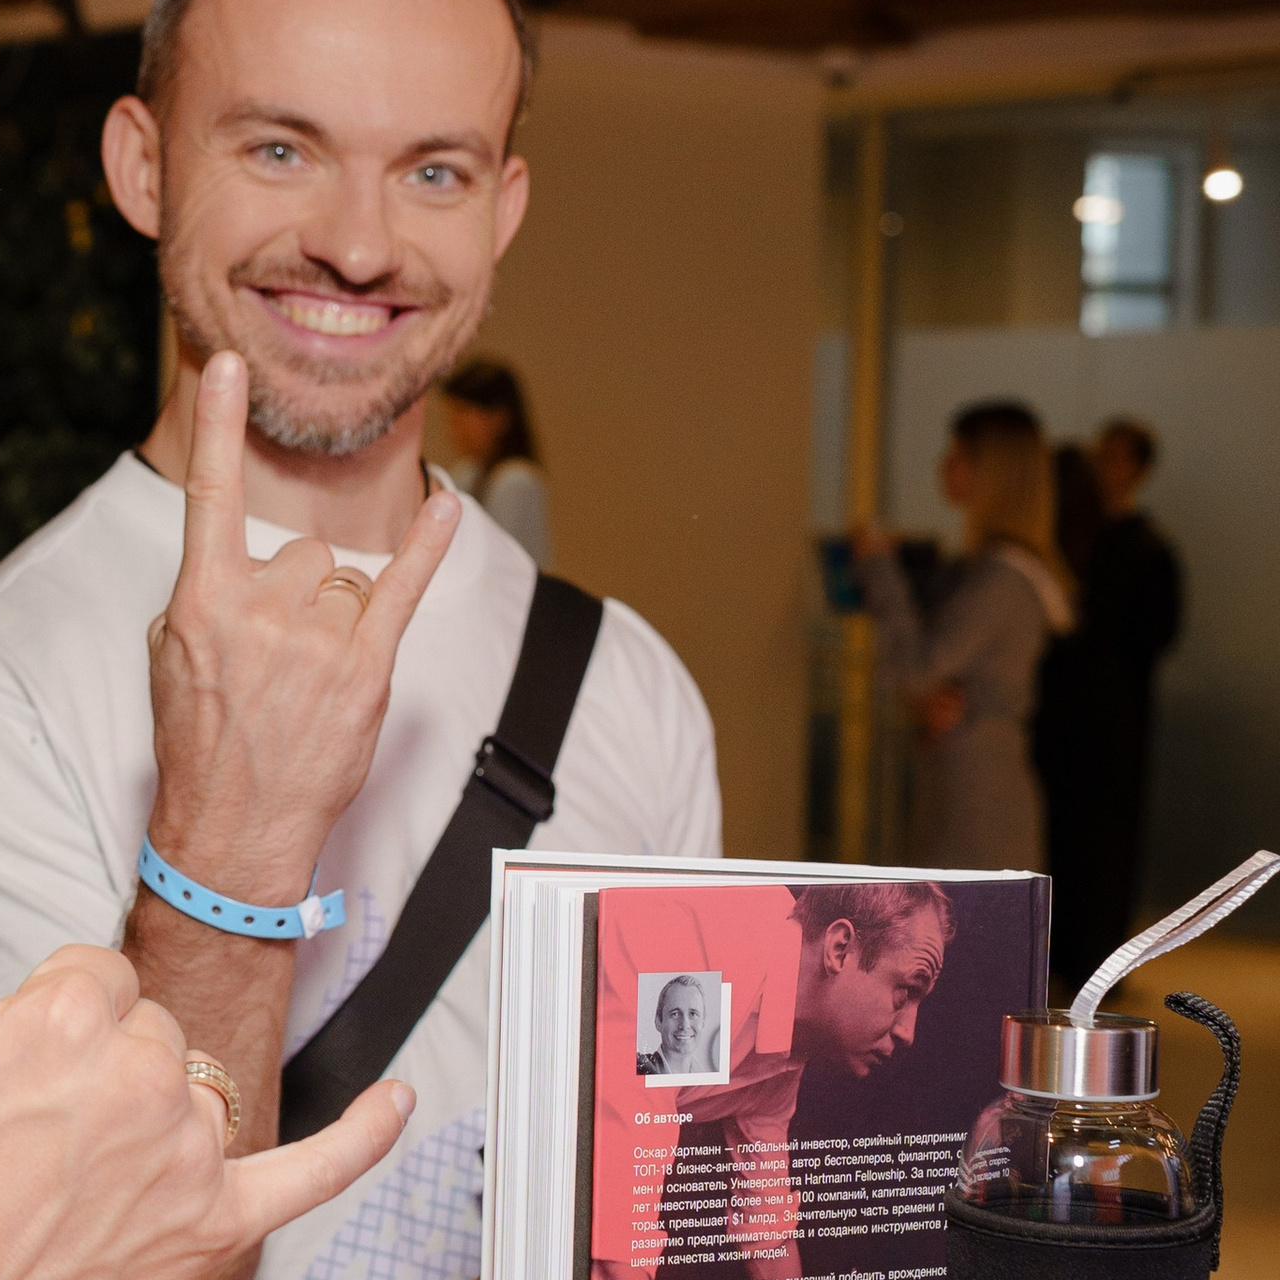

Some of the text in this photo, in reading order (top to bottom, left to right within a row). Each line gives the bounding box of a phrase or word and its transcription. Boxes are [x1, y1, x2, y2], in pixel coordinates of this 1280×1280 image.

[634, 1112, 693, 1125] Об авторе
[633, 1147, 667, 1159] Оскар
[670, 1145, 721, 1159] Хартманн
[737, 1138, 798, 1153] глобальный
[800, 1138, 850, 1150] инвестор,
[852, 1133, 901, 1149] серийный
[635, 1150, 953, 1176] ТОП-18 бизнес-ангелов мира, автор бестселлеров, филантроп,
[633, 1185, 653, 1194] мен
[657, 1184, 663, 1193] и
[666, 1181, 727, 1193] основатель
[730, 1176, 801, 1189] Университета
[804, 1172, 852, 1185] Hartmann
[854, 1168, 907, 1182] Fellowship.
[910, 1166, 923, 1178] За
[632, 1203, 649, 1212] лет
[654, 1198, 727, 1212] инвестировал
[730, 1194, 761, 1207] более
[764, 1195, 783, 1204] чем
[787, 1195, 792, 1203] в
[797, 1190, 814, 1203] 100
[817, 1187, 868, 1201] компаний,
[871, 1185, 945, 1198] капитализация
[632, 1220, 665, 1232] торых
[668, 1216, 729, 1231] превышает
[732, 1212, 743, 1225] $1
[749, 1213, 778, 1225] млрд.
[783, 1208, 857, 1221] Значительную
[860, 1206, 888, 1216] часть
[892, 1203, 934, 1216] времени
[631, 1236, 684, 1251] развитию
[687, 1229, 805, 1248] предпринимательства
[808, 1228, 814, 1237] и
[817, 1224, 868, 1238] созданию
[871, 1220, 941, 1234] инструментов
[631, 1245, 789, 1267] шения качества жизни людей.
